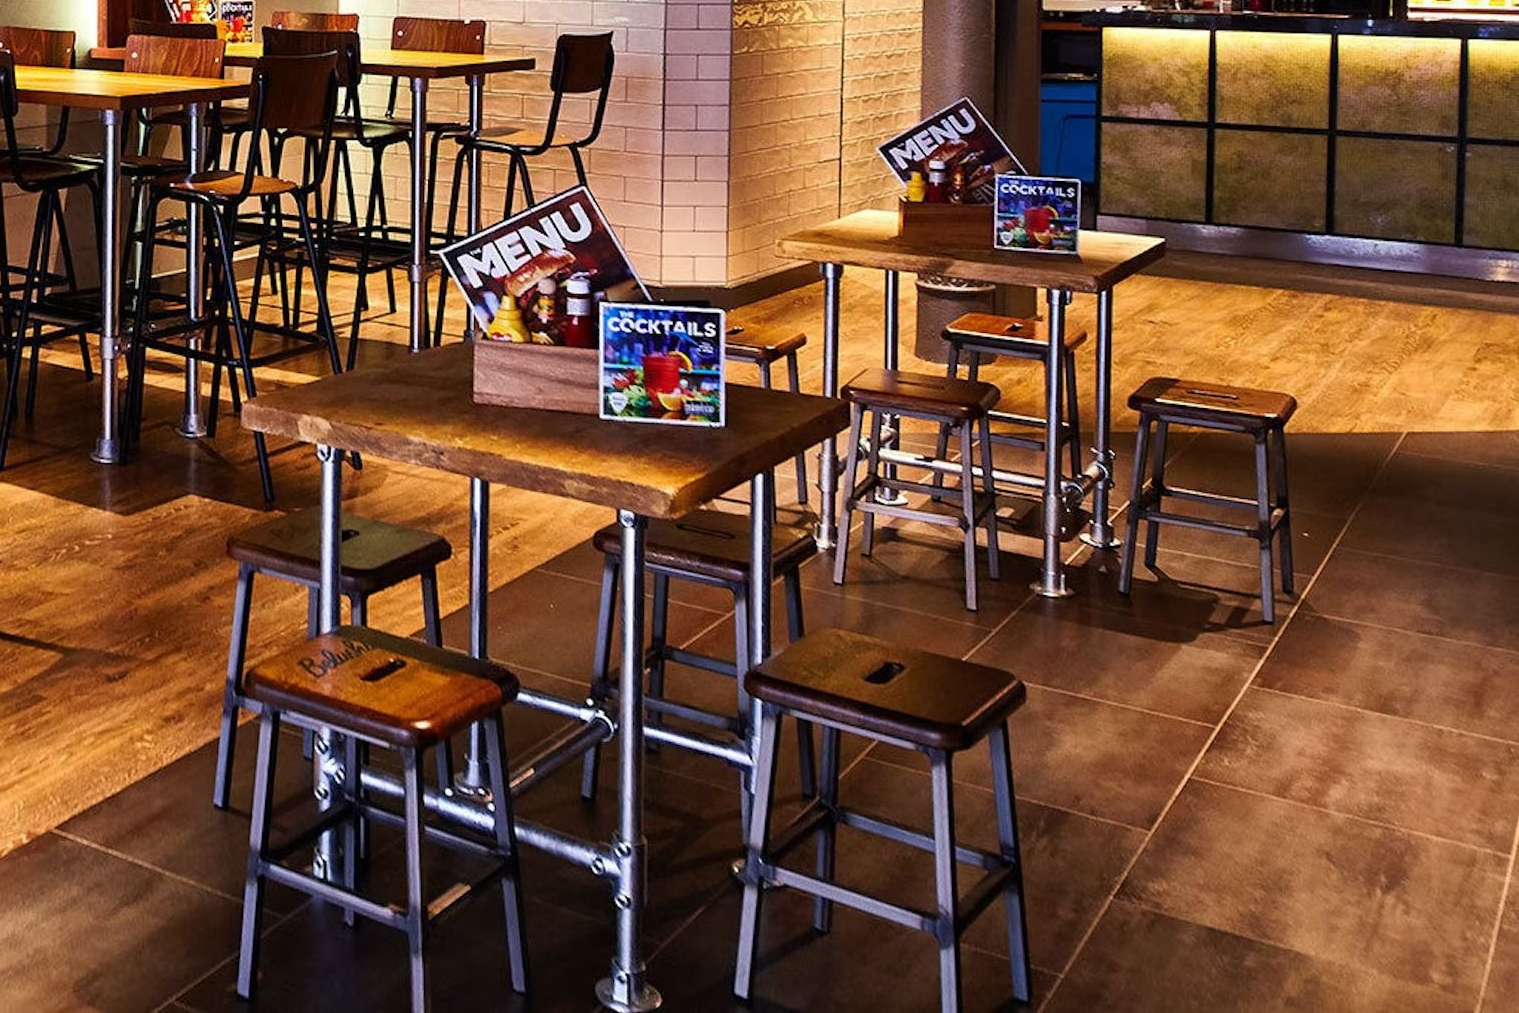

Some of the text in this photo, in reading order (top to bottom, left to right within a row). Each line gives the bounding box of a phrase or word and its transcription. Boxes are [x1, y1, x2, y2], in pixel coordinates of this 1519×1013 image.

[888, 108, 977, 170] MENU
[1001, 183, 1076, 199] COCKTAILS
[456, 202, 592, 289] MENU
[607, 316, 718, 338] COCKTAILS
